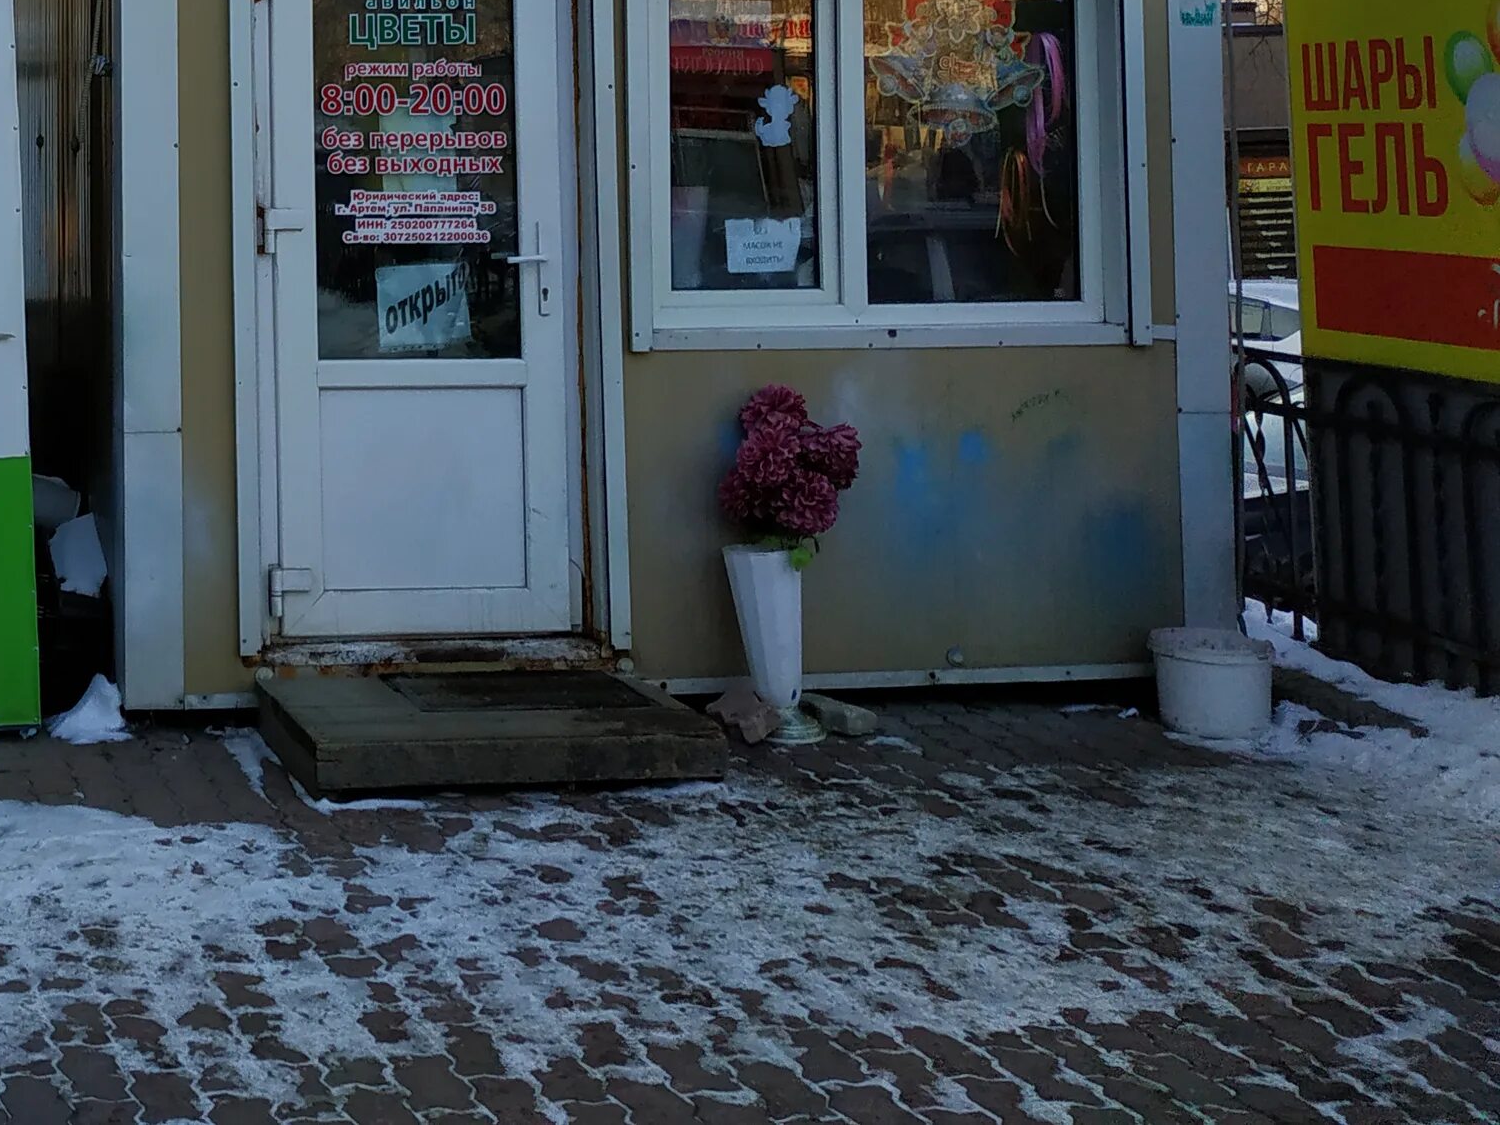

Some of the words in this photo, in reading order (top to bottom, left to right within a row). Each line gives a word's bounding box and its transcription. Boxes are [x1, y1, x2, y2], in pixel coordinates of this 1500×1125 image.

[349, 13, 476, 50] ЦВЕТЫ
[345, 62, 408, 80] режим
[413, 58, 482, 80] работы
[1301, 35, 1437, 111] ШАРЫ
[321, 83, 506, 115] 8:00-20:00
[322, 126, 364, 149] без
[370, 131, 507, 153] перерывов
[328, 151, 370, 174] без
[376, 156, 503, 176] выходных
[1306, 122, 1448, 217] ГЕЛЬ
[351, 190, 437, 202] Юридический
[440, 192, 479, 203] адрес:
[393, 204, 411, 215] ул.
[414, 203, 477, 215] Папанина,
[480, 202, 496, 214] 58
[356, 219, 388, 230] ИНН:
